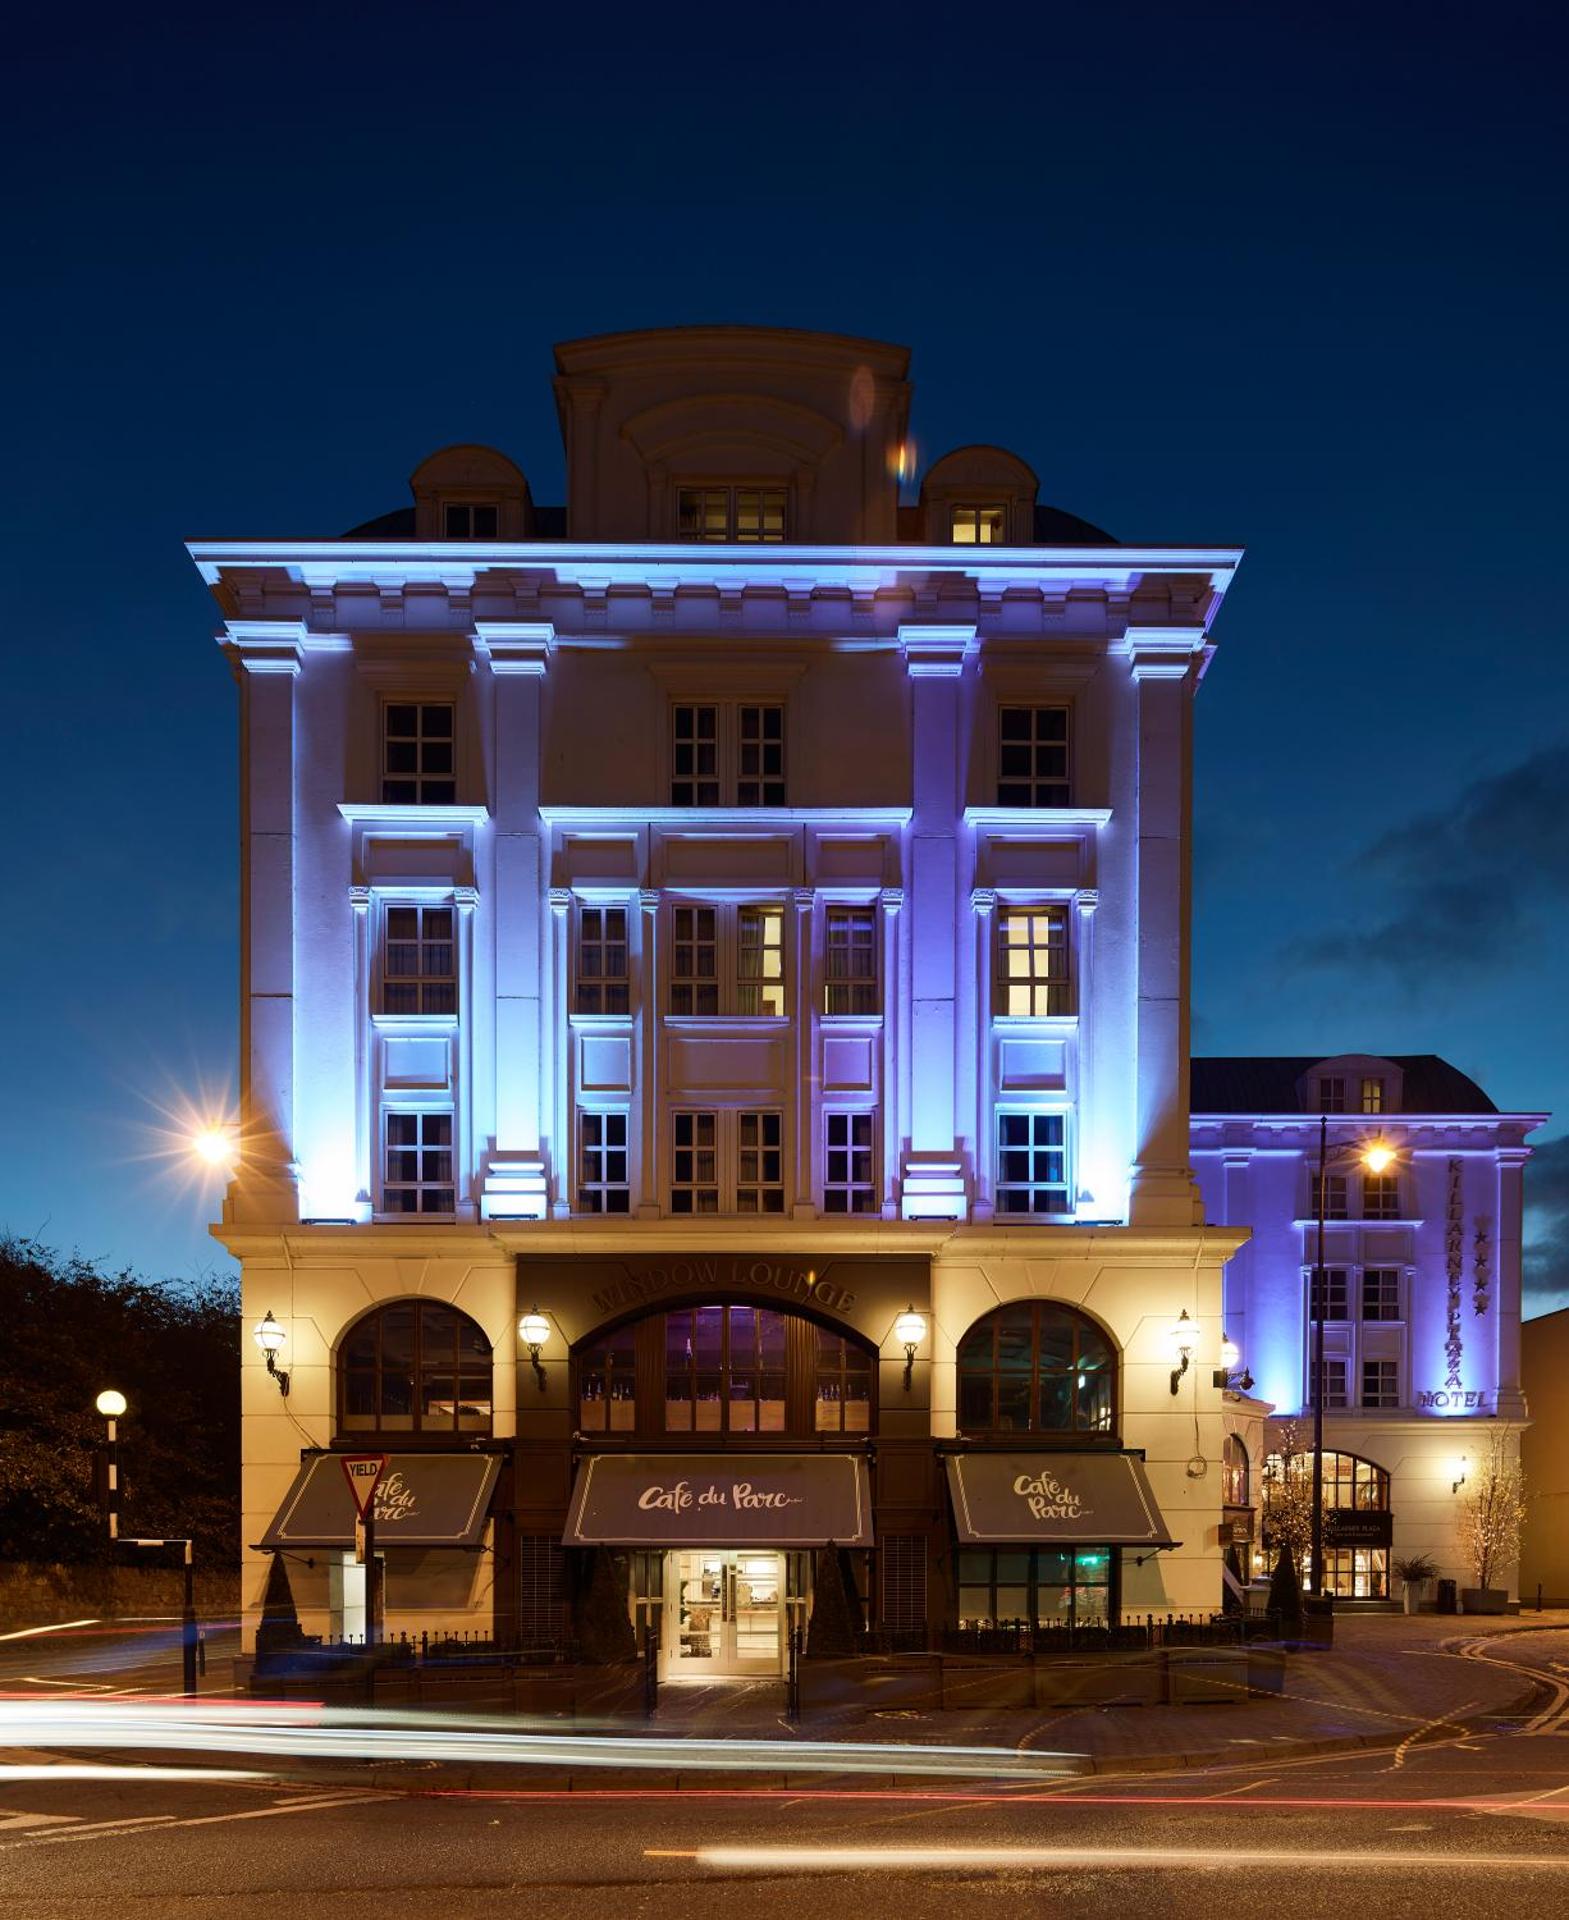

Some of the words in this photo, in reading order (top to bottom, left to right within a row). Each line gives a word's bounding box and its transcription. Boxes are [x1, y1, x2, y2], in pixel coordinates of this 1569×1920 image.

[1446, 1158, 1463, 1296] KILLARNEY
[591, 1260, 719, 1315] WINDOW
[731, 1260, 858, 1315] LOUNGE
[1445, 1311, 1463, 1388] PLAZA
[1416, 1390, 1490, 1408] HOTEL
[349, 1463, 378, 1476] YIELD
[374, 1472, 404, 1501] afé
[390, 1489, 416, 1507] du
[638, 1481, 693, 1515] Café
[698, 1485, 727, 1505] du
[732, 1482, 791, 1510] Parc
[1014, 1471, 1061, 1500] Café
[1055, 1487, 1081, 1506] du
[1028, 1496, 1082, 1519] Parc
